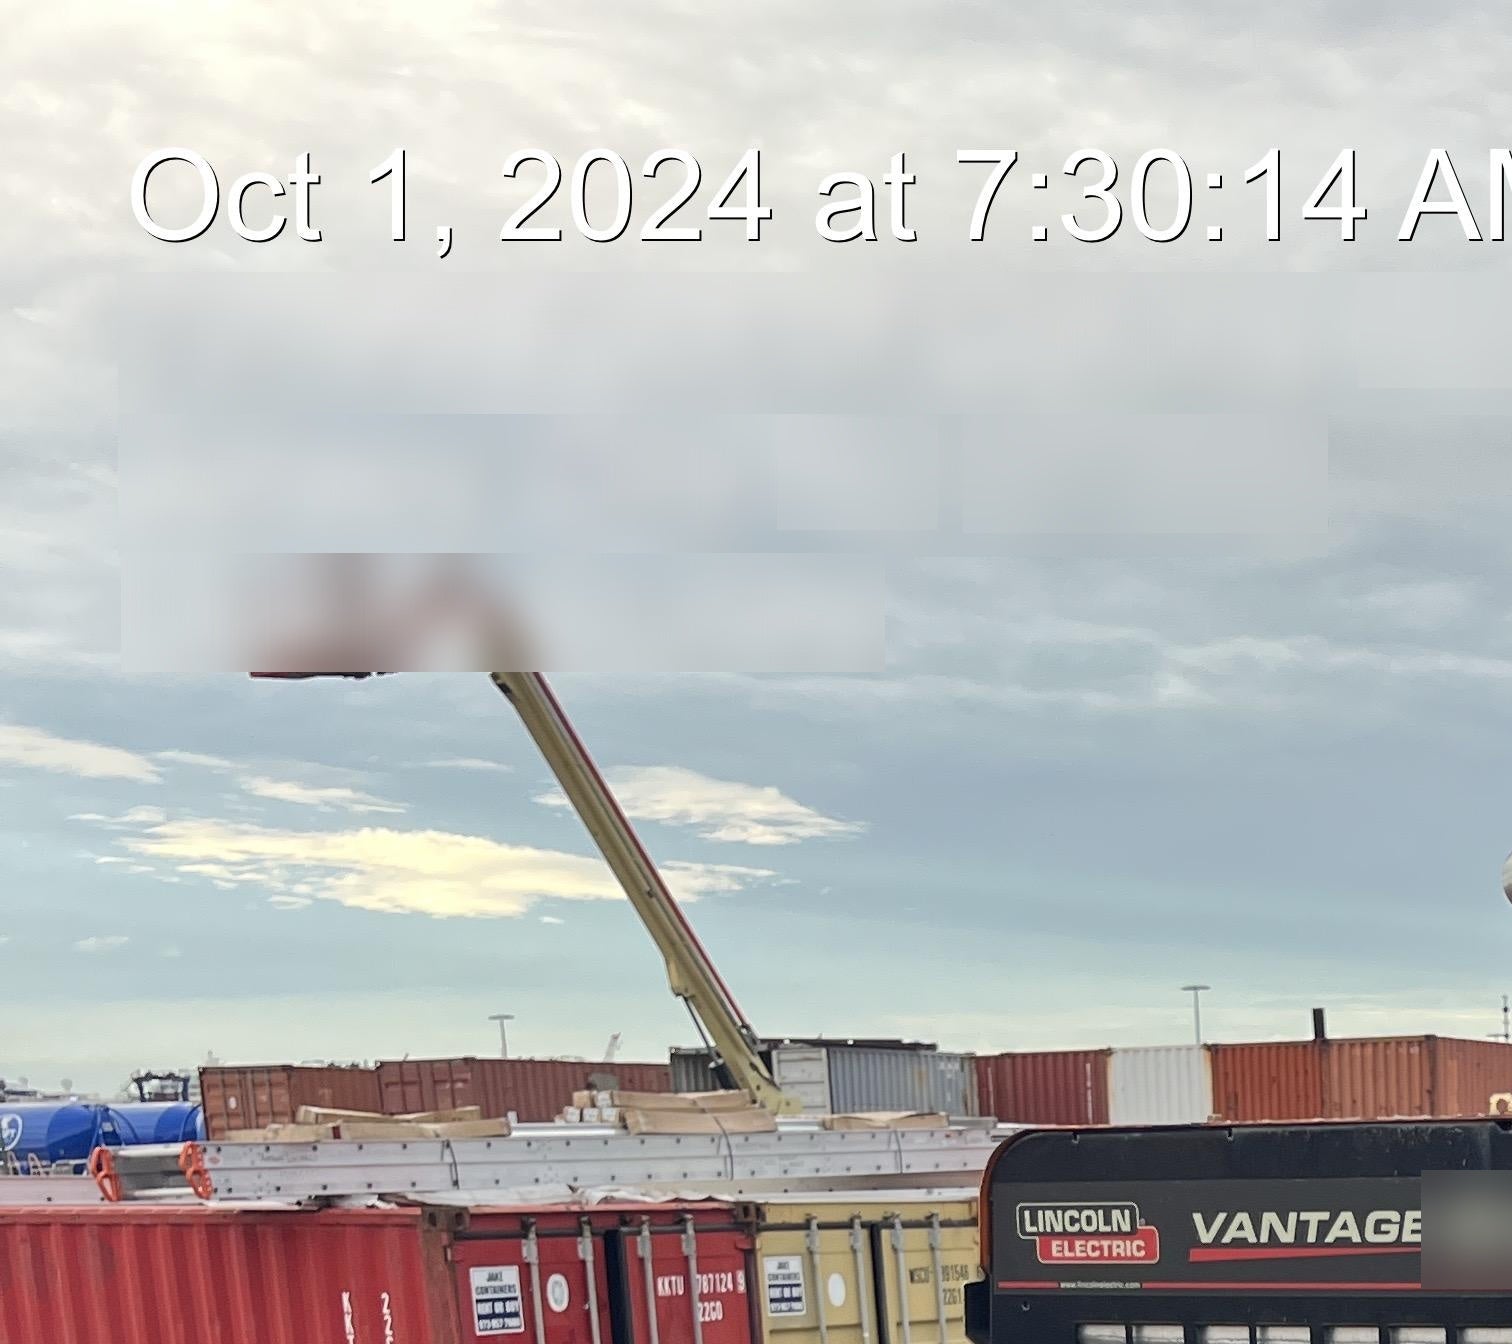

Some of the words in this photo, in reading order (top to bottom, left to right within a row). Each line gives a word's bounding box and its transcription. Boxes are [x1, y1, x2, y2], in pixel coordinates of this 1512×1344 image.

[1023, 1209, 1132, 1234] LINCOLN
[1191, 1210, 1422, 1244] VANTAGE
[1051, 1239, 1147, 1258] ELECTRIC
[657, 1275, 684, 1297] KKTU
[695, 1271, 735, 1295] 787124
